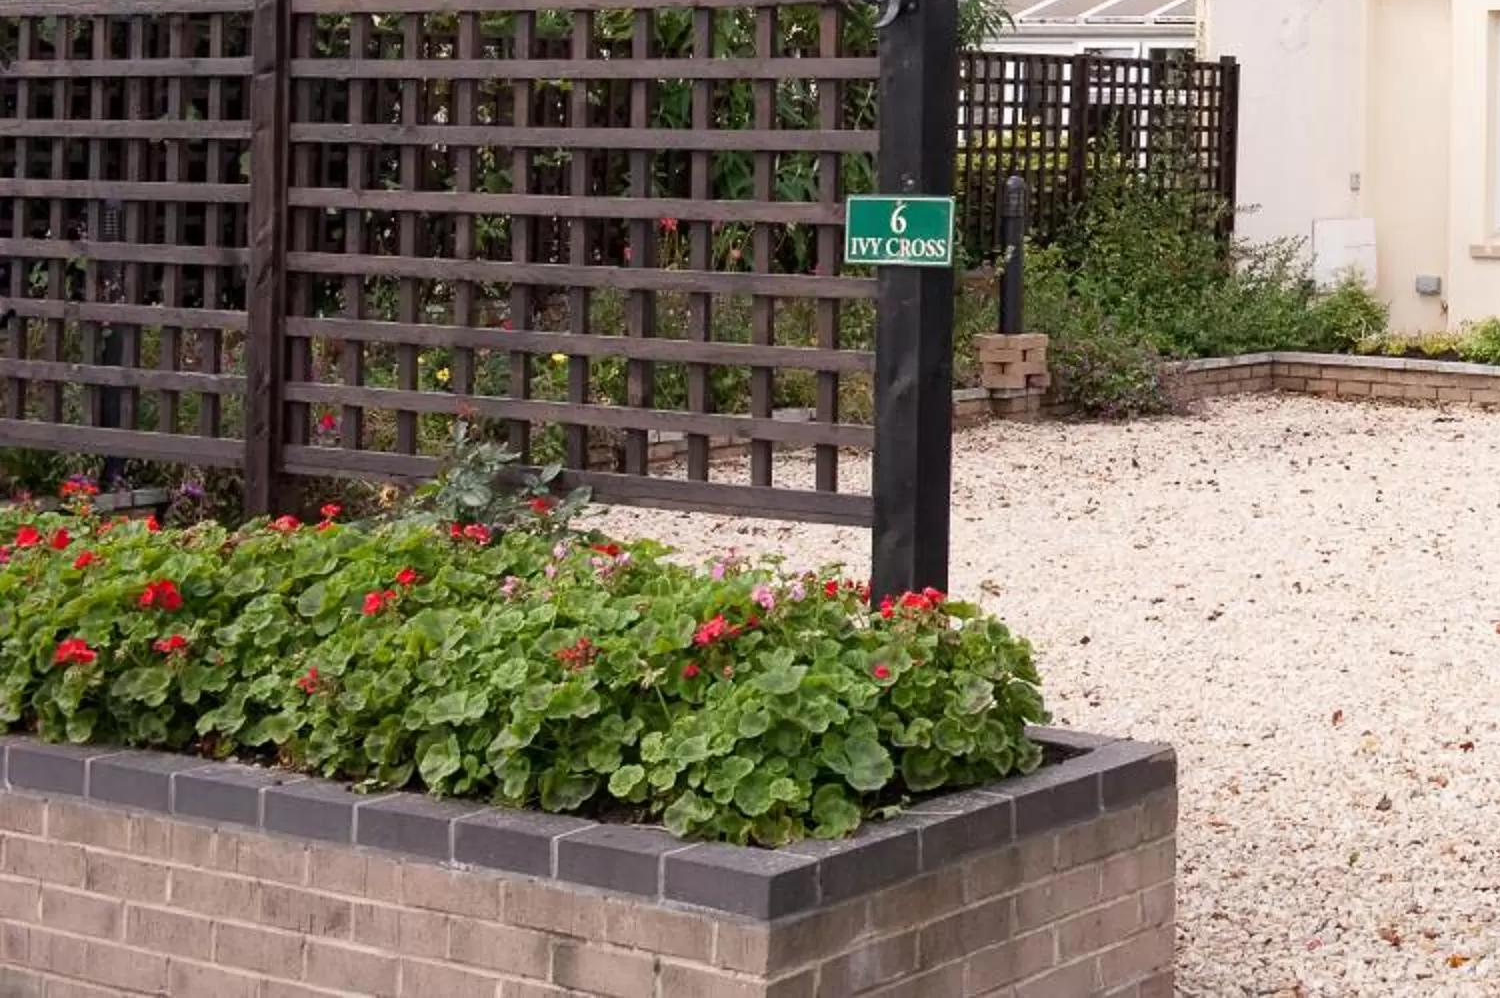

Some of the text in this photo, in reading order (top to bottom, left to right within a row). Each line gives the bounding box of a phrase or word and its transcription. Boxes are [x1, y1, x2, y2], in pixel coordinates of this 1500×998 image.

[890, 204, 906, 233] 6
[851, 237, 946, 257] IVY CROSS
